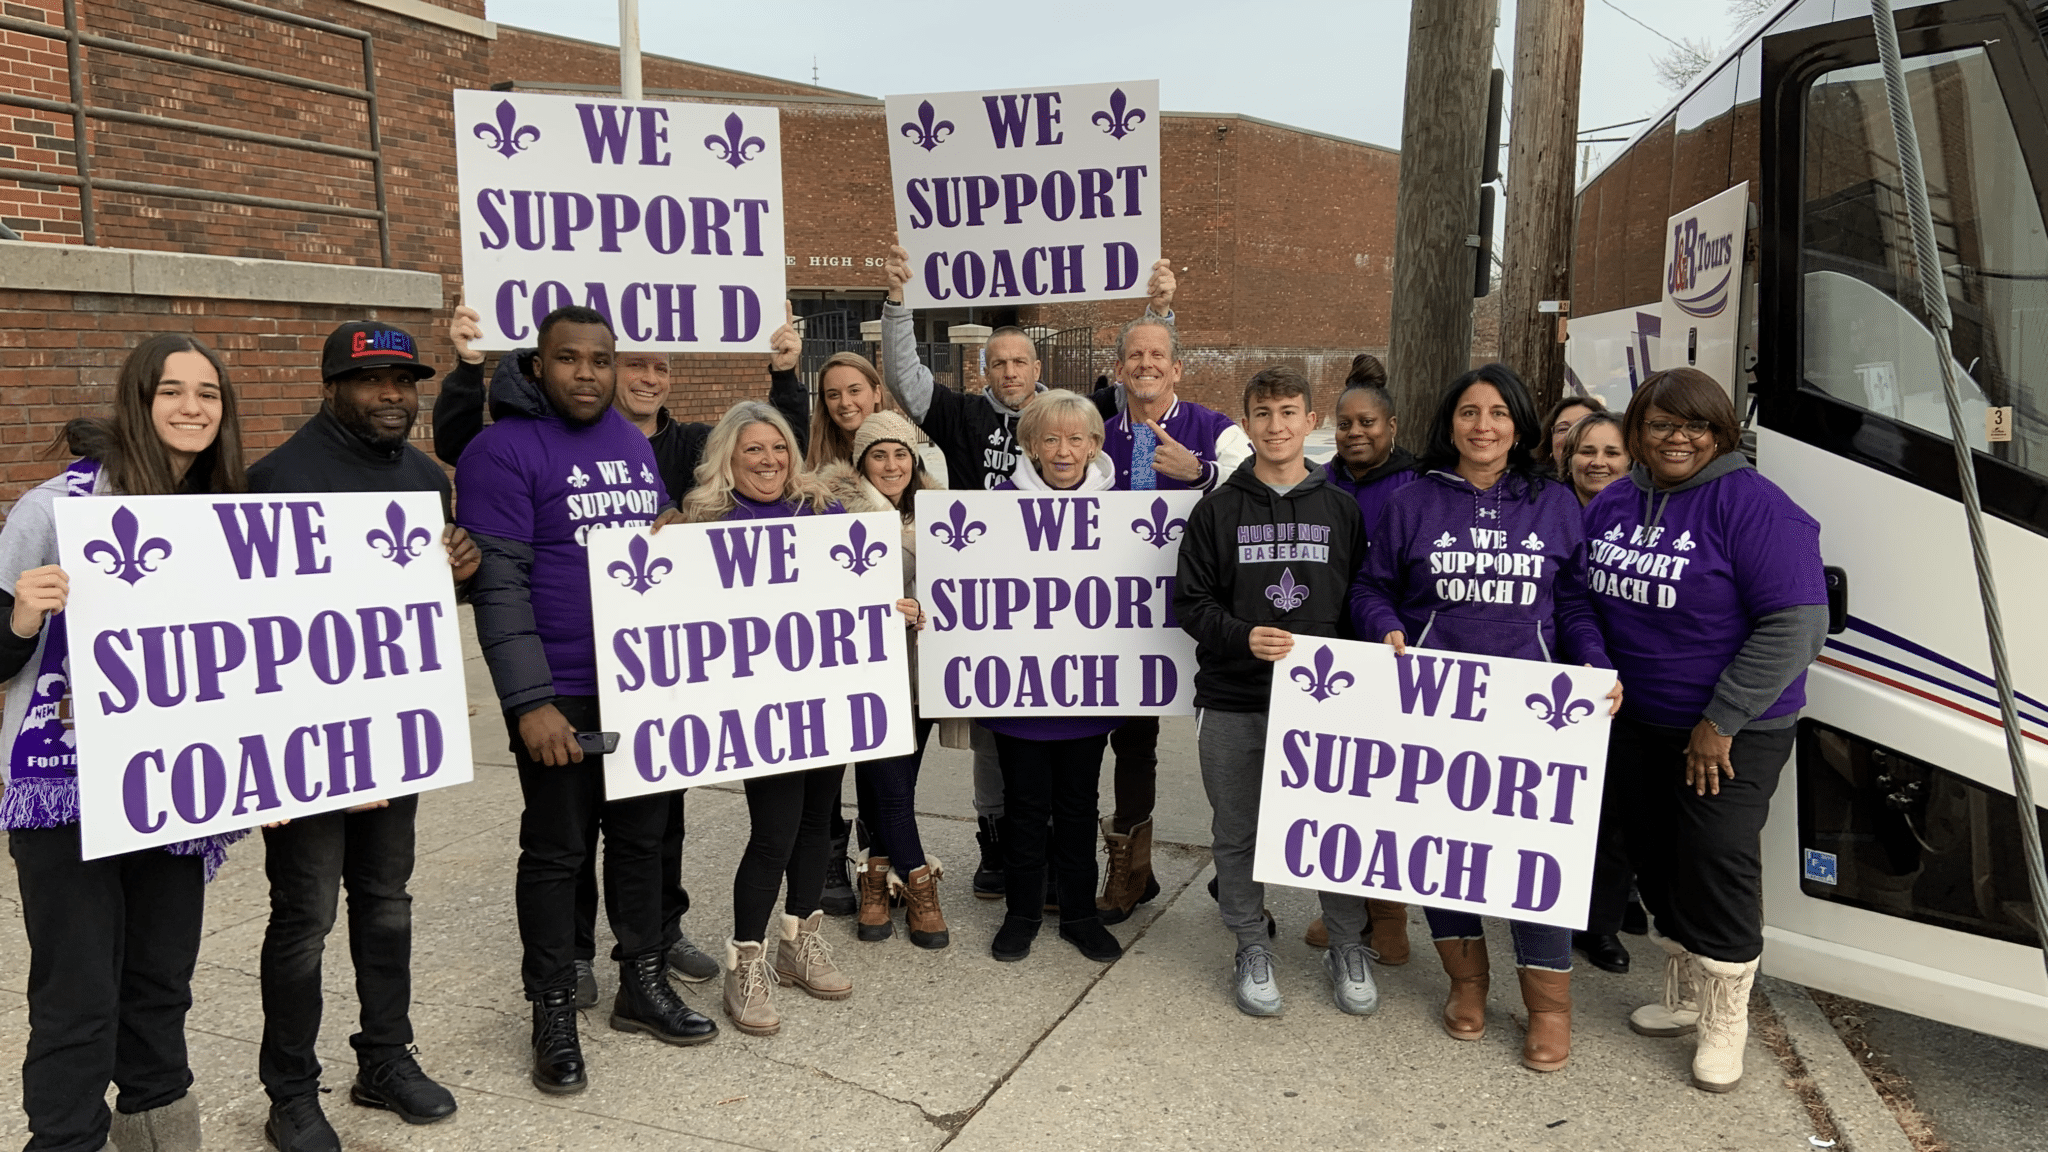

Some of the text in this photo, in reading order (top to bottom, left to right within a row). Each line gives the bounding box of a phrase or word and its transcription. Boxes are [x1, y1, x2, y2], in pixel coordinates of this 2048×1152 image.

[575, 103, 671, 166] WE
[982, 92, 1064, 149] WE
[477, 188, 769, 257] SUPPORT
[906, 165, 1148, 229] SUPPORT
[809, 256, 853, 267] HIGH
[924, 241, 1139, 301] COACH D
[1696, 231, 1733, 272] Tours
[719, 285, 761, 342] D
[1995, 410, 2003, 425] 3
[595, 460, 632, 485] WE
[567, 489, 658, 521] SUPPORT
[1017, 497, 1101, 551] WE
[212, 501, 332, 580] WE
[706, 523, 799, 589] WE
[1244, 545, 1326, 560] BASEBALL
[1469, 527, 1507, 549] WE
[1589, 539, 1690, 580] SUPPORT
[1630, 524, 1665, 548] WE
[1430, 551, 1545, 578] SUPPORT
[1436, 578, 1537, 605] COACH D
[1588, 566, 1677, 609] COACH D
[931, 575, 1183, 631] SUPPORT
[93, 601, 443, 716] SUPPORT
[612, 603, 891, 693] SUPPORT
[944, 654, 1178, 709] COACH D
[1394, 652, 1491, 722] WE
[35, 705, 55, 719] NEW
[634, 692, 888, 782] COACH D
[122, 708, 443, 834] COACH D
[1281, 728, 1587, 825] SUPPORT
[1284, 818, 1562, 913] COACH D
